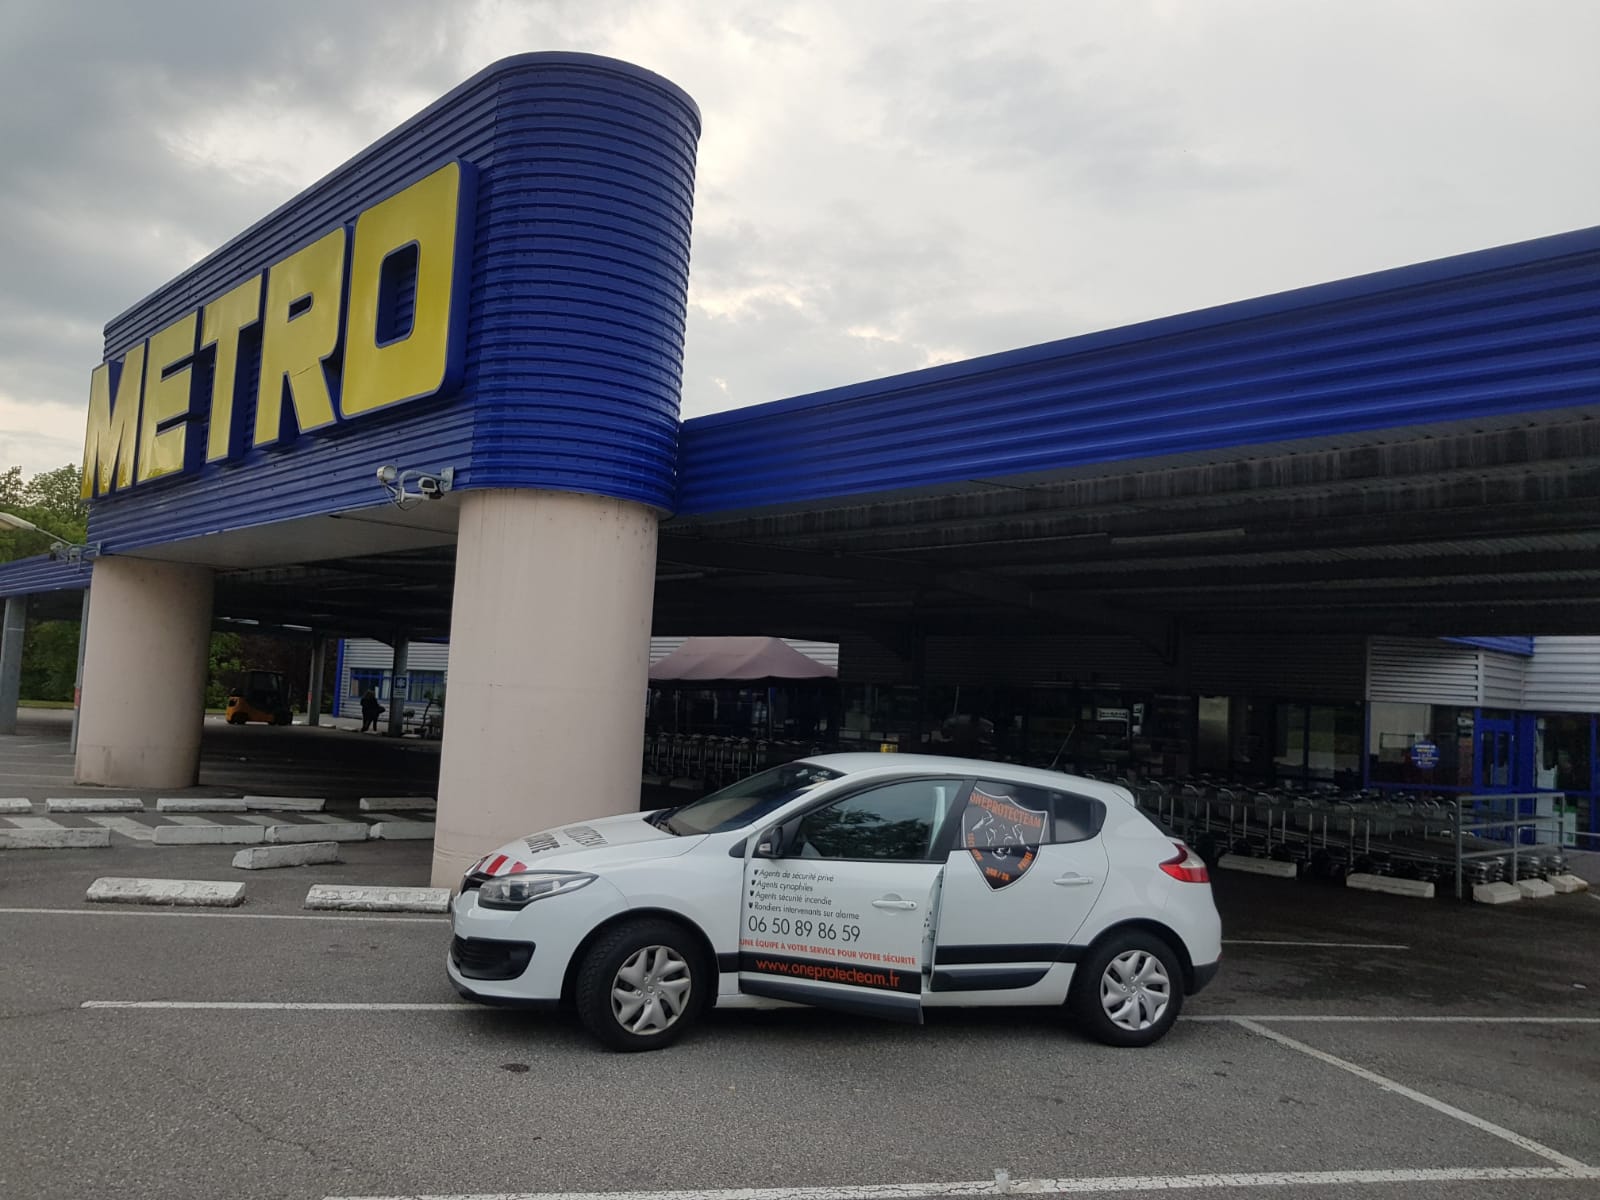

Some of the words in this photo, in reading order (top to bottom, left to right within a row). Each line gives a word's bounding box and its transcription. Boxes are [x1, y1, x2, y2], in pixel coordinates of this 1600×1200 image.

[80, 161, 461, 499] METRO
[759, 869, 780, 879] Agents
[782, 870, 791, 878] de
[792, 871, 817, 880] sécurité
[756, 880, 778, 890] Agents
[779, 882, 813, 893] cynophiles
[755, 891, 777, 901] Agents
[779, 892, 803, 903] sécurité
[805, 894, 832, 905] incendie
[754, 902, 782, 912] Rondiers
[783, 904, 822, 916] intervenants
[836, 909, 860, 920] alarme
[748, 915, 767, 933] 06
[772, 918, 790, 935] 50
[795, 920, 813, 938] 89
[818, 922, 837, 940] 86
[842, 925, 861, 943] 59
[740, 938, 754, 947] UNE
[755, 939, 779, 950] ÉQUIPE
[787, 944, 808, 953] VOTRE
[809, 945, 836, 957] SERVICE
[837, 949, 857, 959] POUR
[858, 951, 881, 962] VOTRE
[756, 959, 900, 988] www.oneprotecteam.fr
